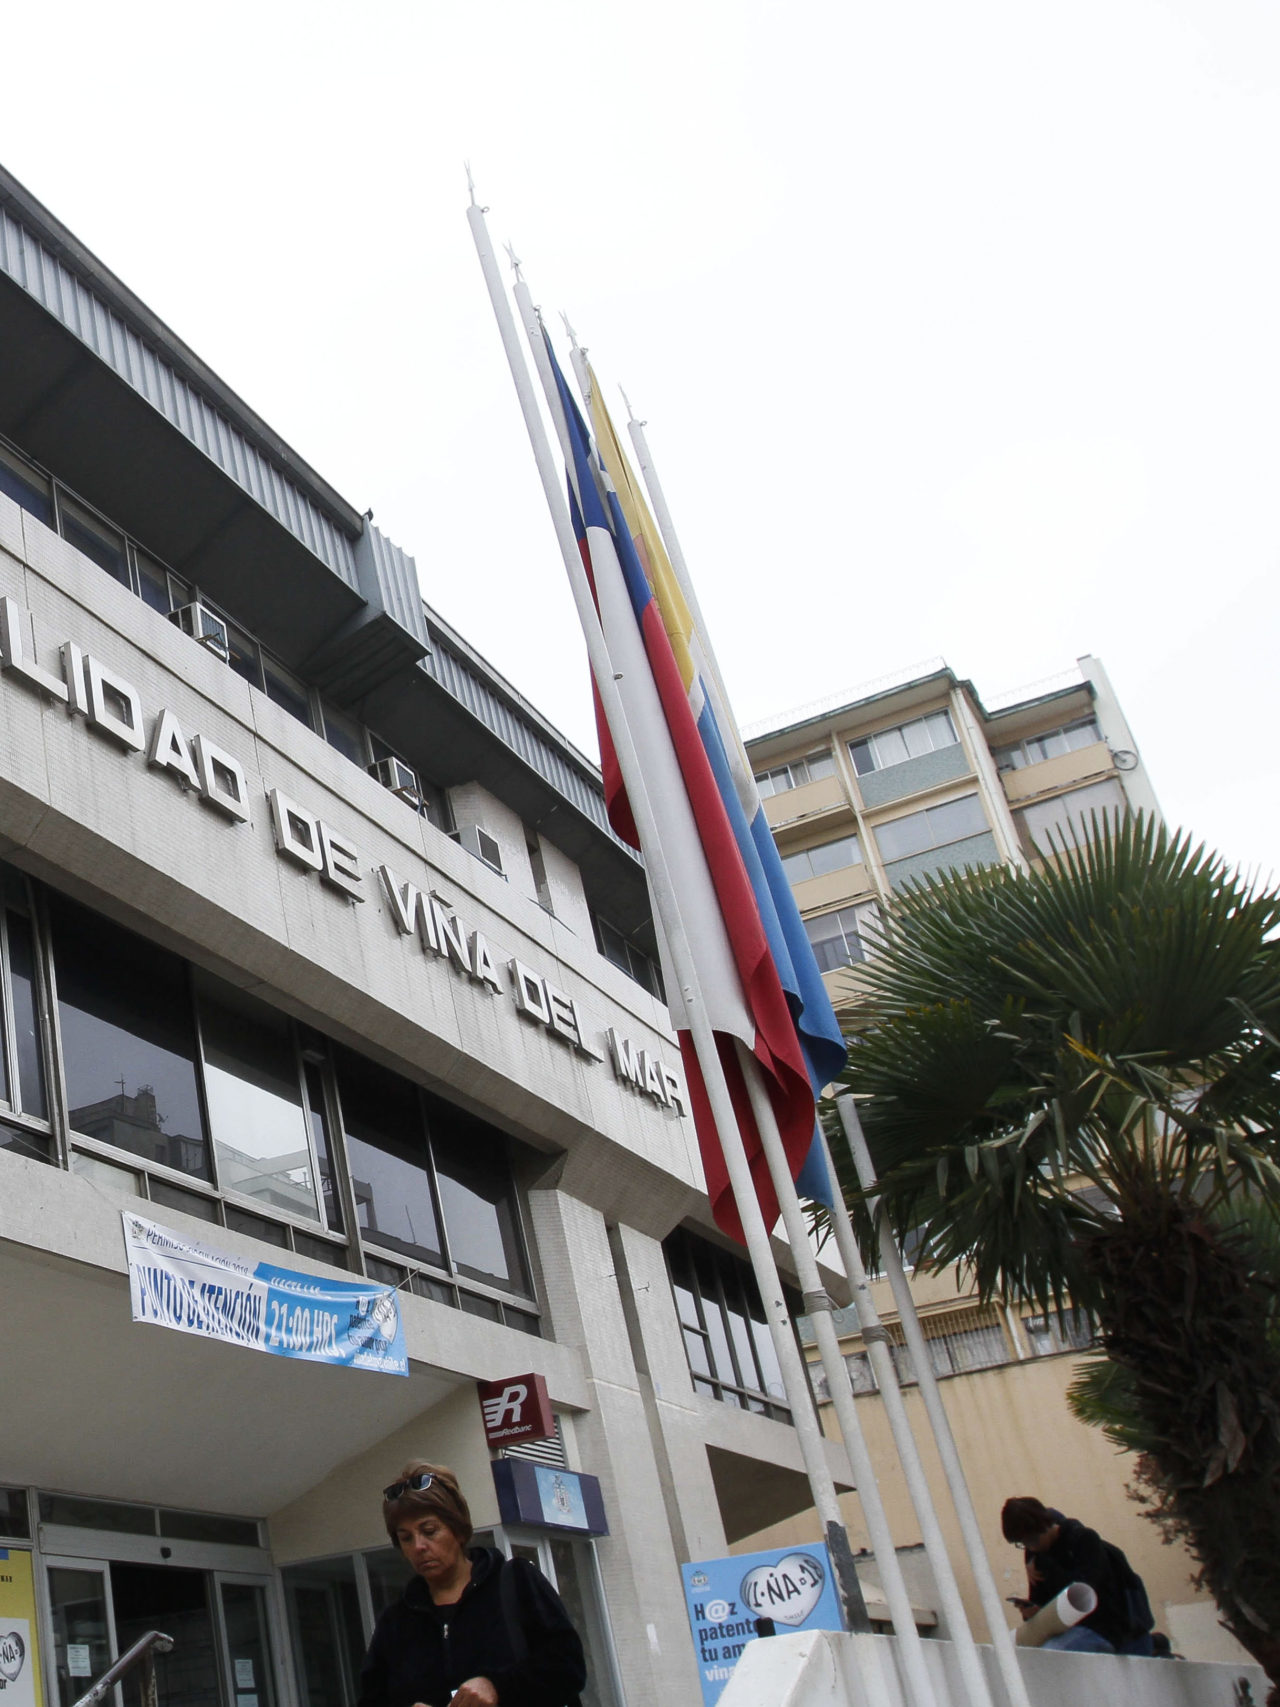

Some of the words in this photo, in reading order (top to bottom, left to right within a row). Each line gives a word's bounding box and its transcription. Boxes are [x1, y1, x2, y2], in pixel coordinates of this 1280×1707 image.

[270, 788, 365, 903] DE
[378, 865, 504, 996] VIÑA
[509, 958, 604, 1064] DEL
[606, 1027, 687, 1118] MAR
[136, 1264, 183, 1325] PUNTO
[201, 1282, 262, 1344] ATENCIÓN
[269, 1300, 311, 1352] 21:00
[700, 1646, 719, 1663] tu
